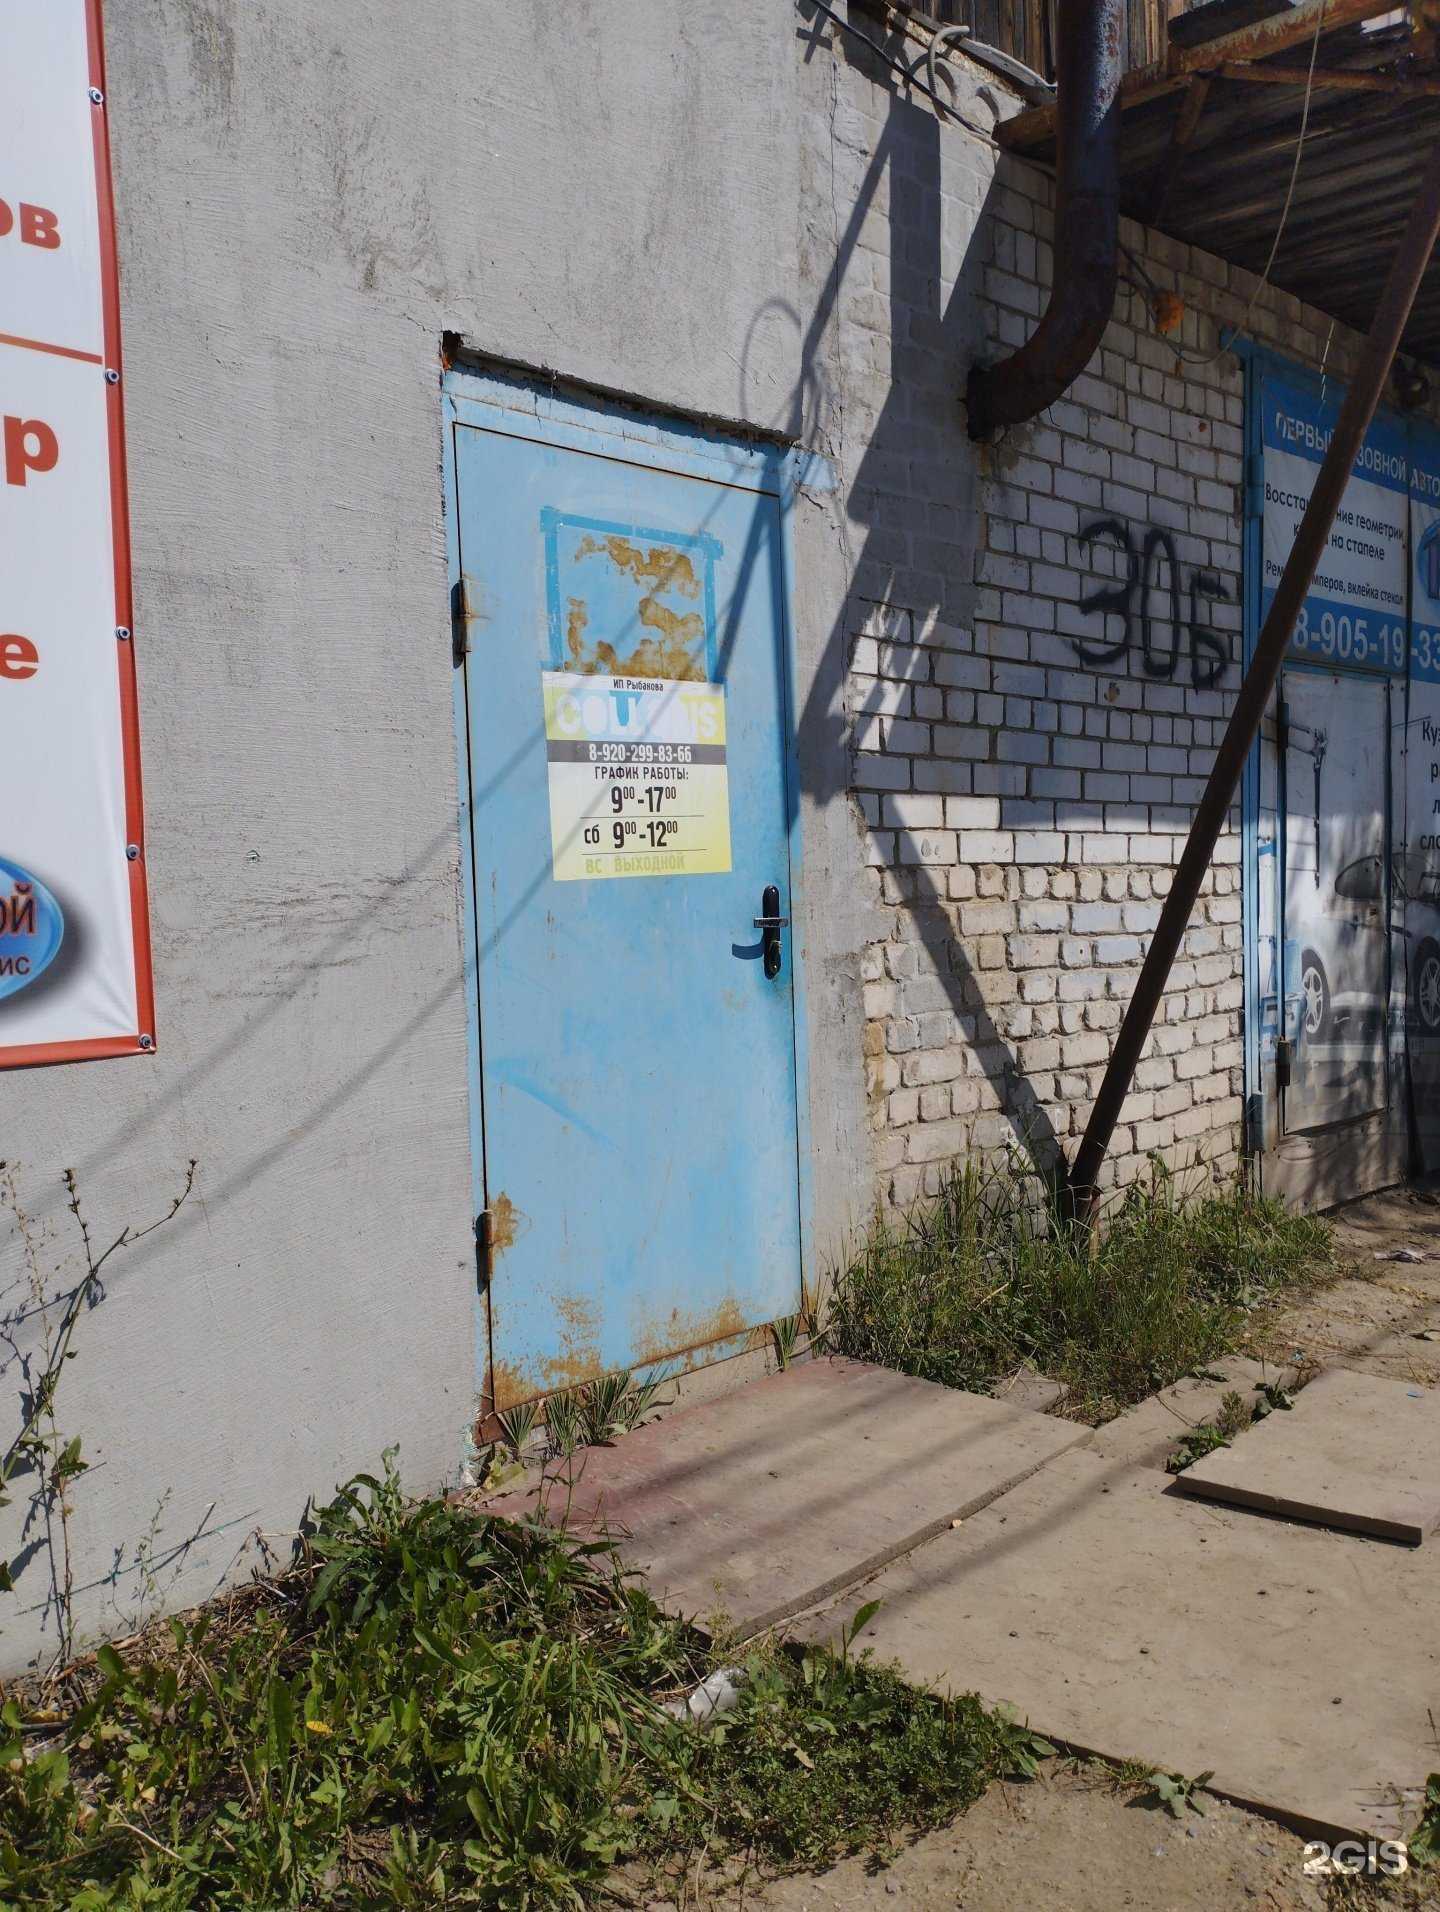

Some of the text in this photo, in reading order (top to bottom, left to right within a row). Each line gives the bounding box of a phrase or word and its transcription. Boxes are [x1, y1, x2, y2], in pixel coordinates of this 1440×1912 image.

[1275, 411, 1336, 453] ПЕРВЫ
[1353, 445, 1407, 482] ЗОВНОЙ
[1331, 534, 1385, 561] на стапеле
[613, 678, 624, 689] ИП
[594, 765, 689, 780] ГРАФИК РАБОТЫ:
[585, 851, 686, 874] ВС ВЫХОДНОЙ
